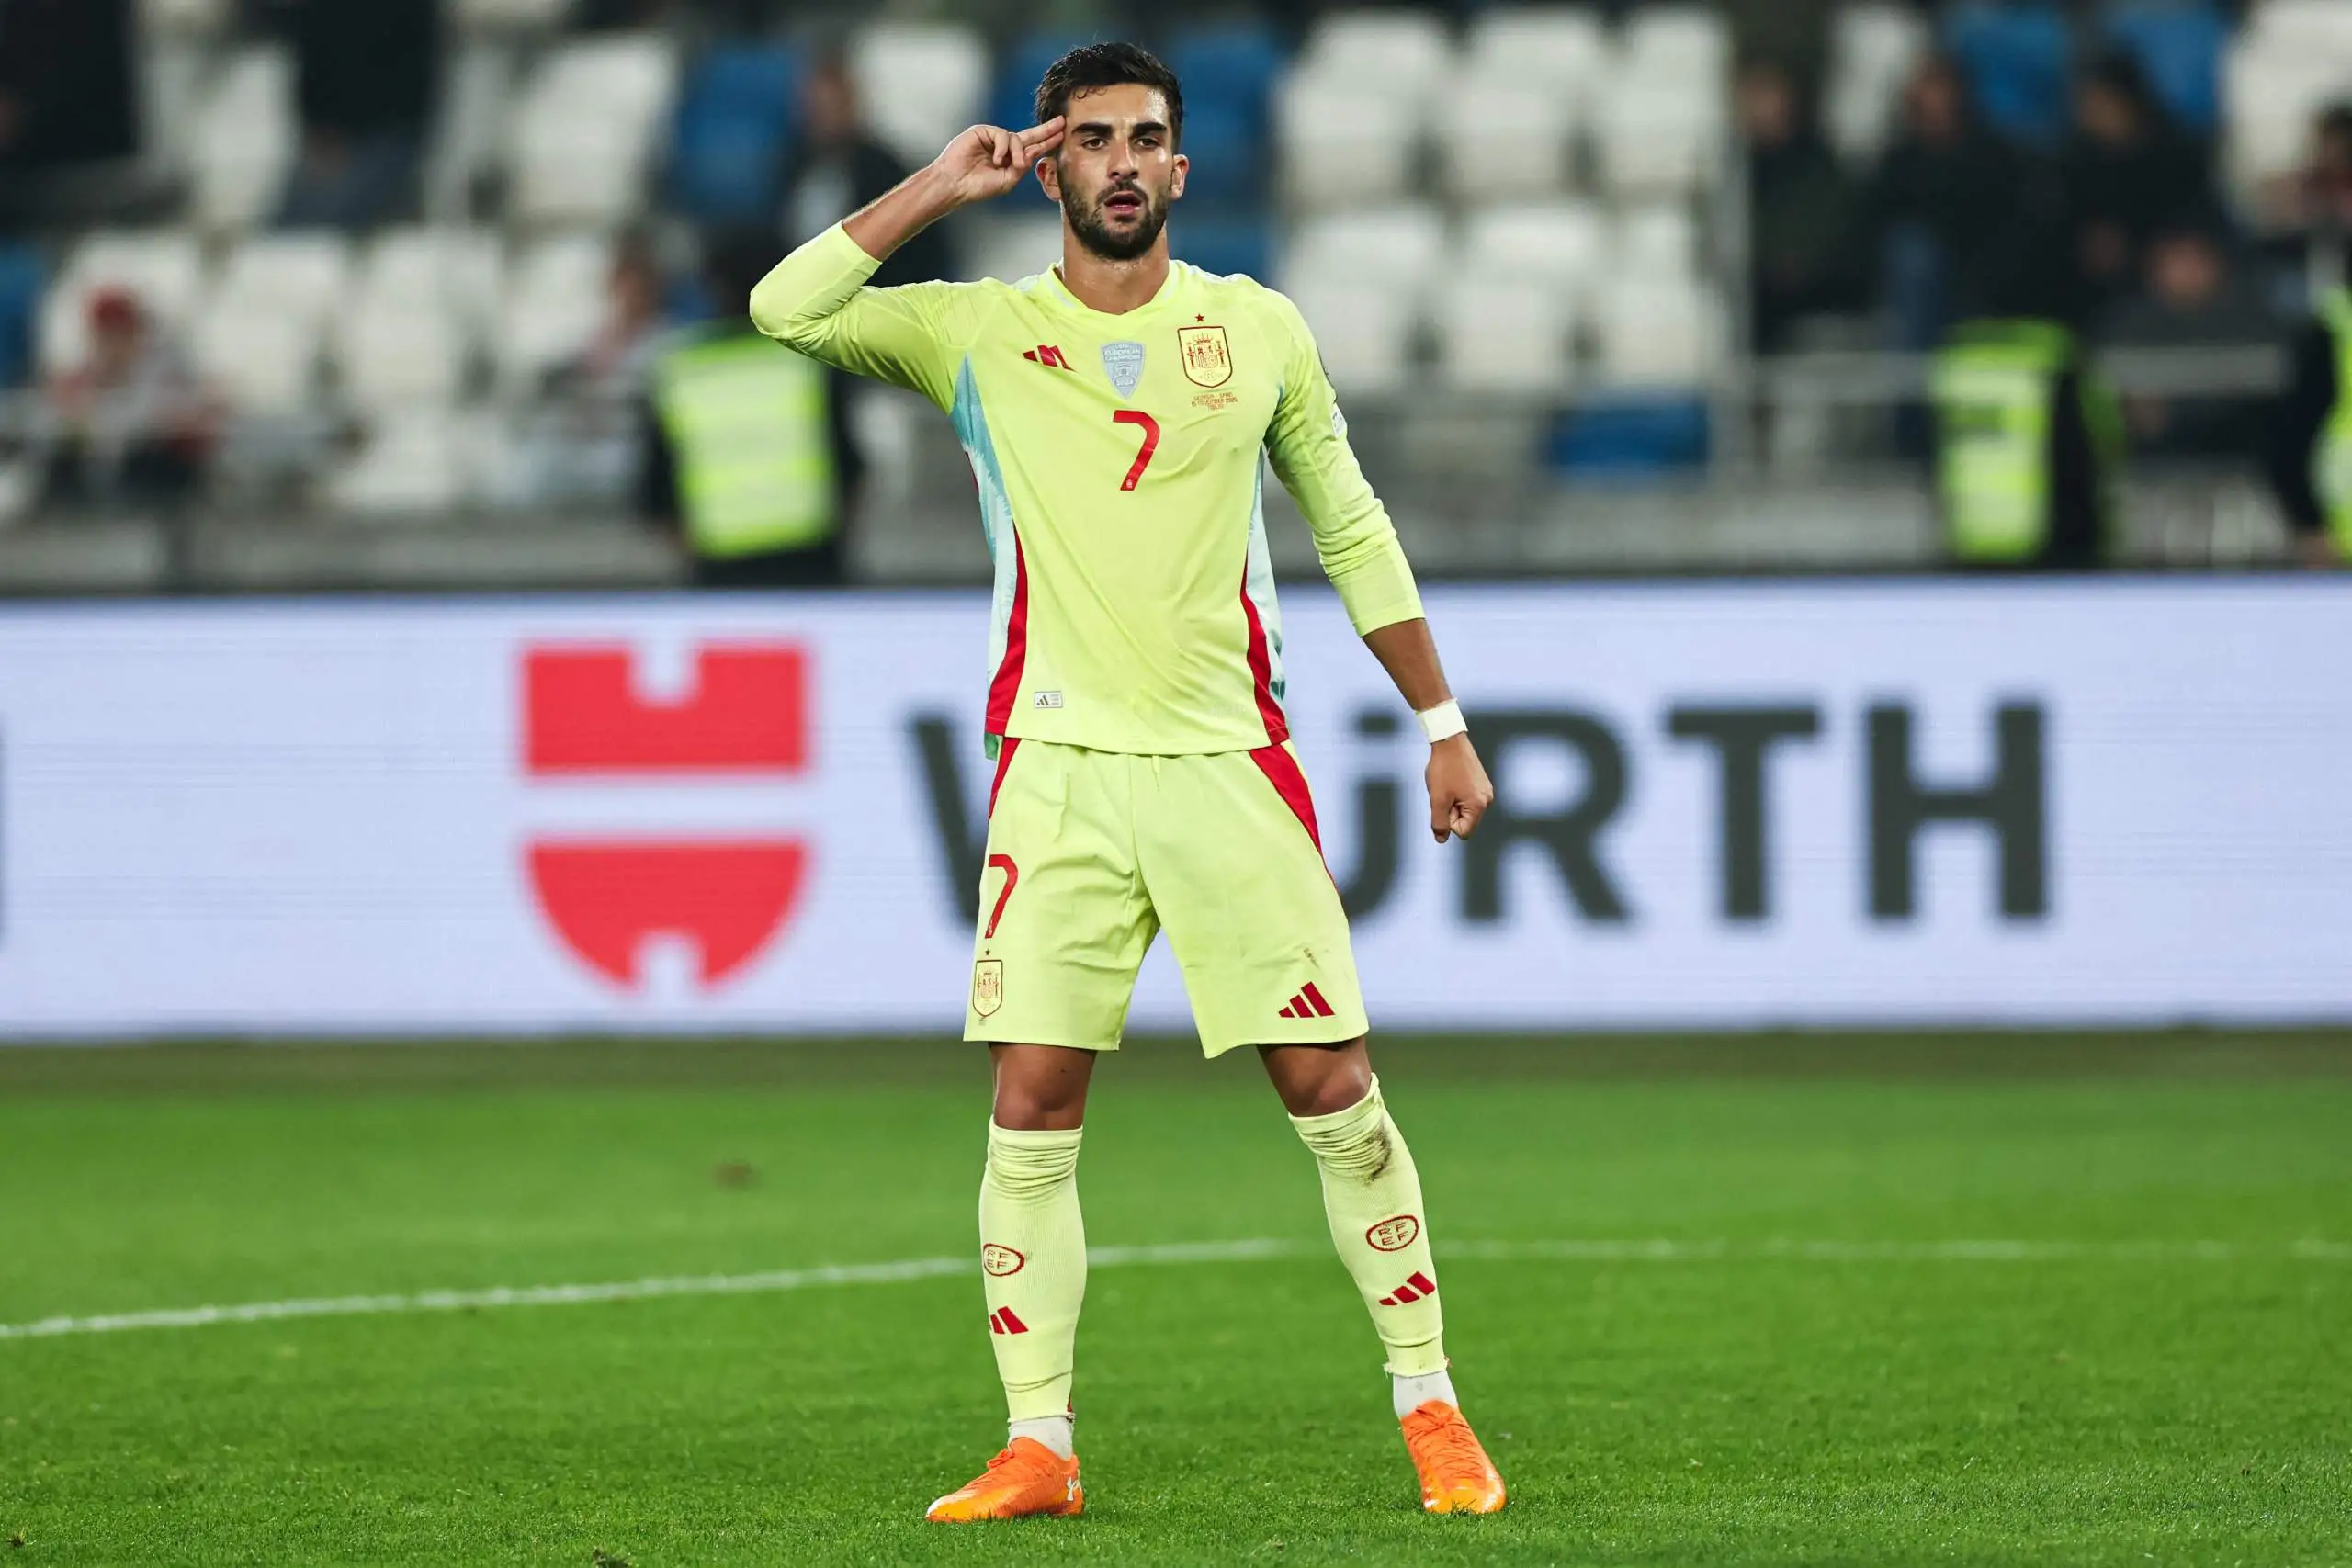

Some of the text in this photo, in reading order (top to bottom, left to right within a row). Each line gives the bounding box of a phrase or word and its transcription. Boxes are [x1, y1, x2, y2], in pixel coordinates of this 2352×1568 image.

[1113, 410, 1160, 491] 7
[904, 702, 2051, 924] RTH
[985, 854, 1018, 938] 7
